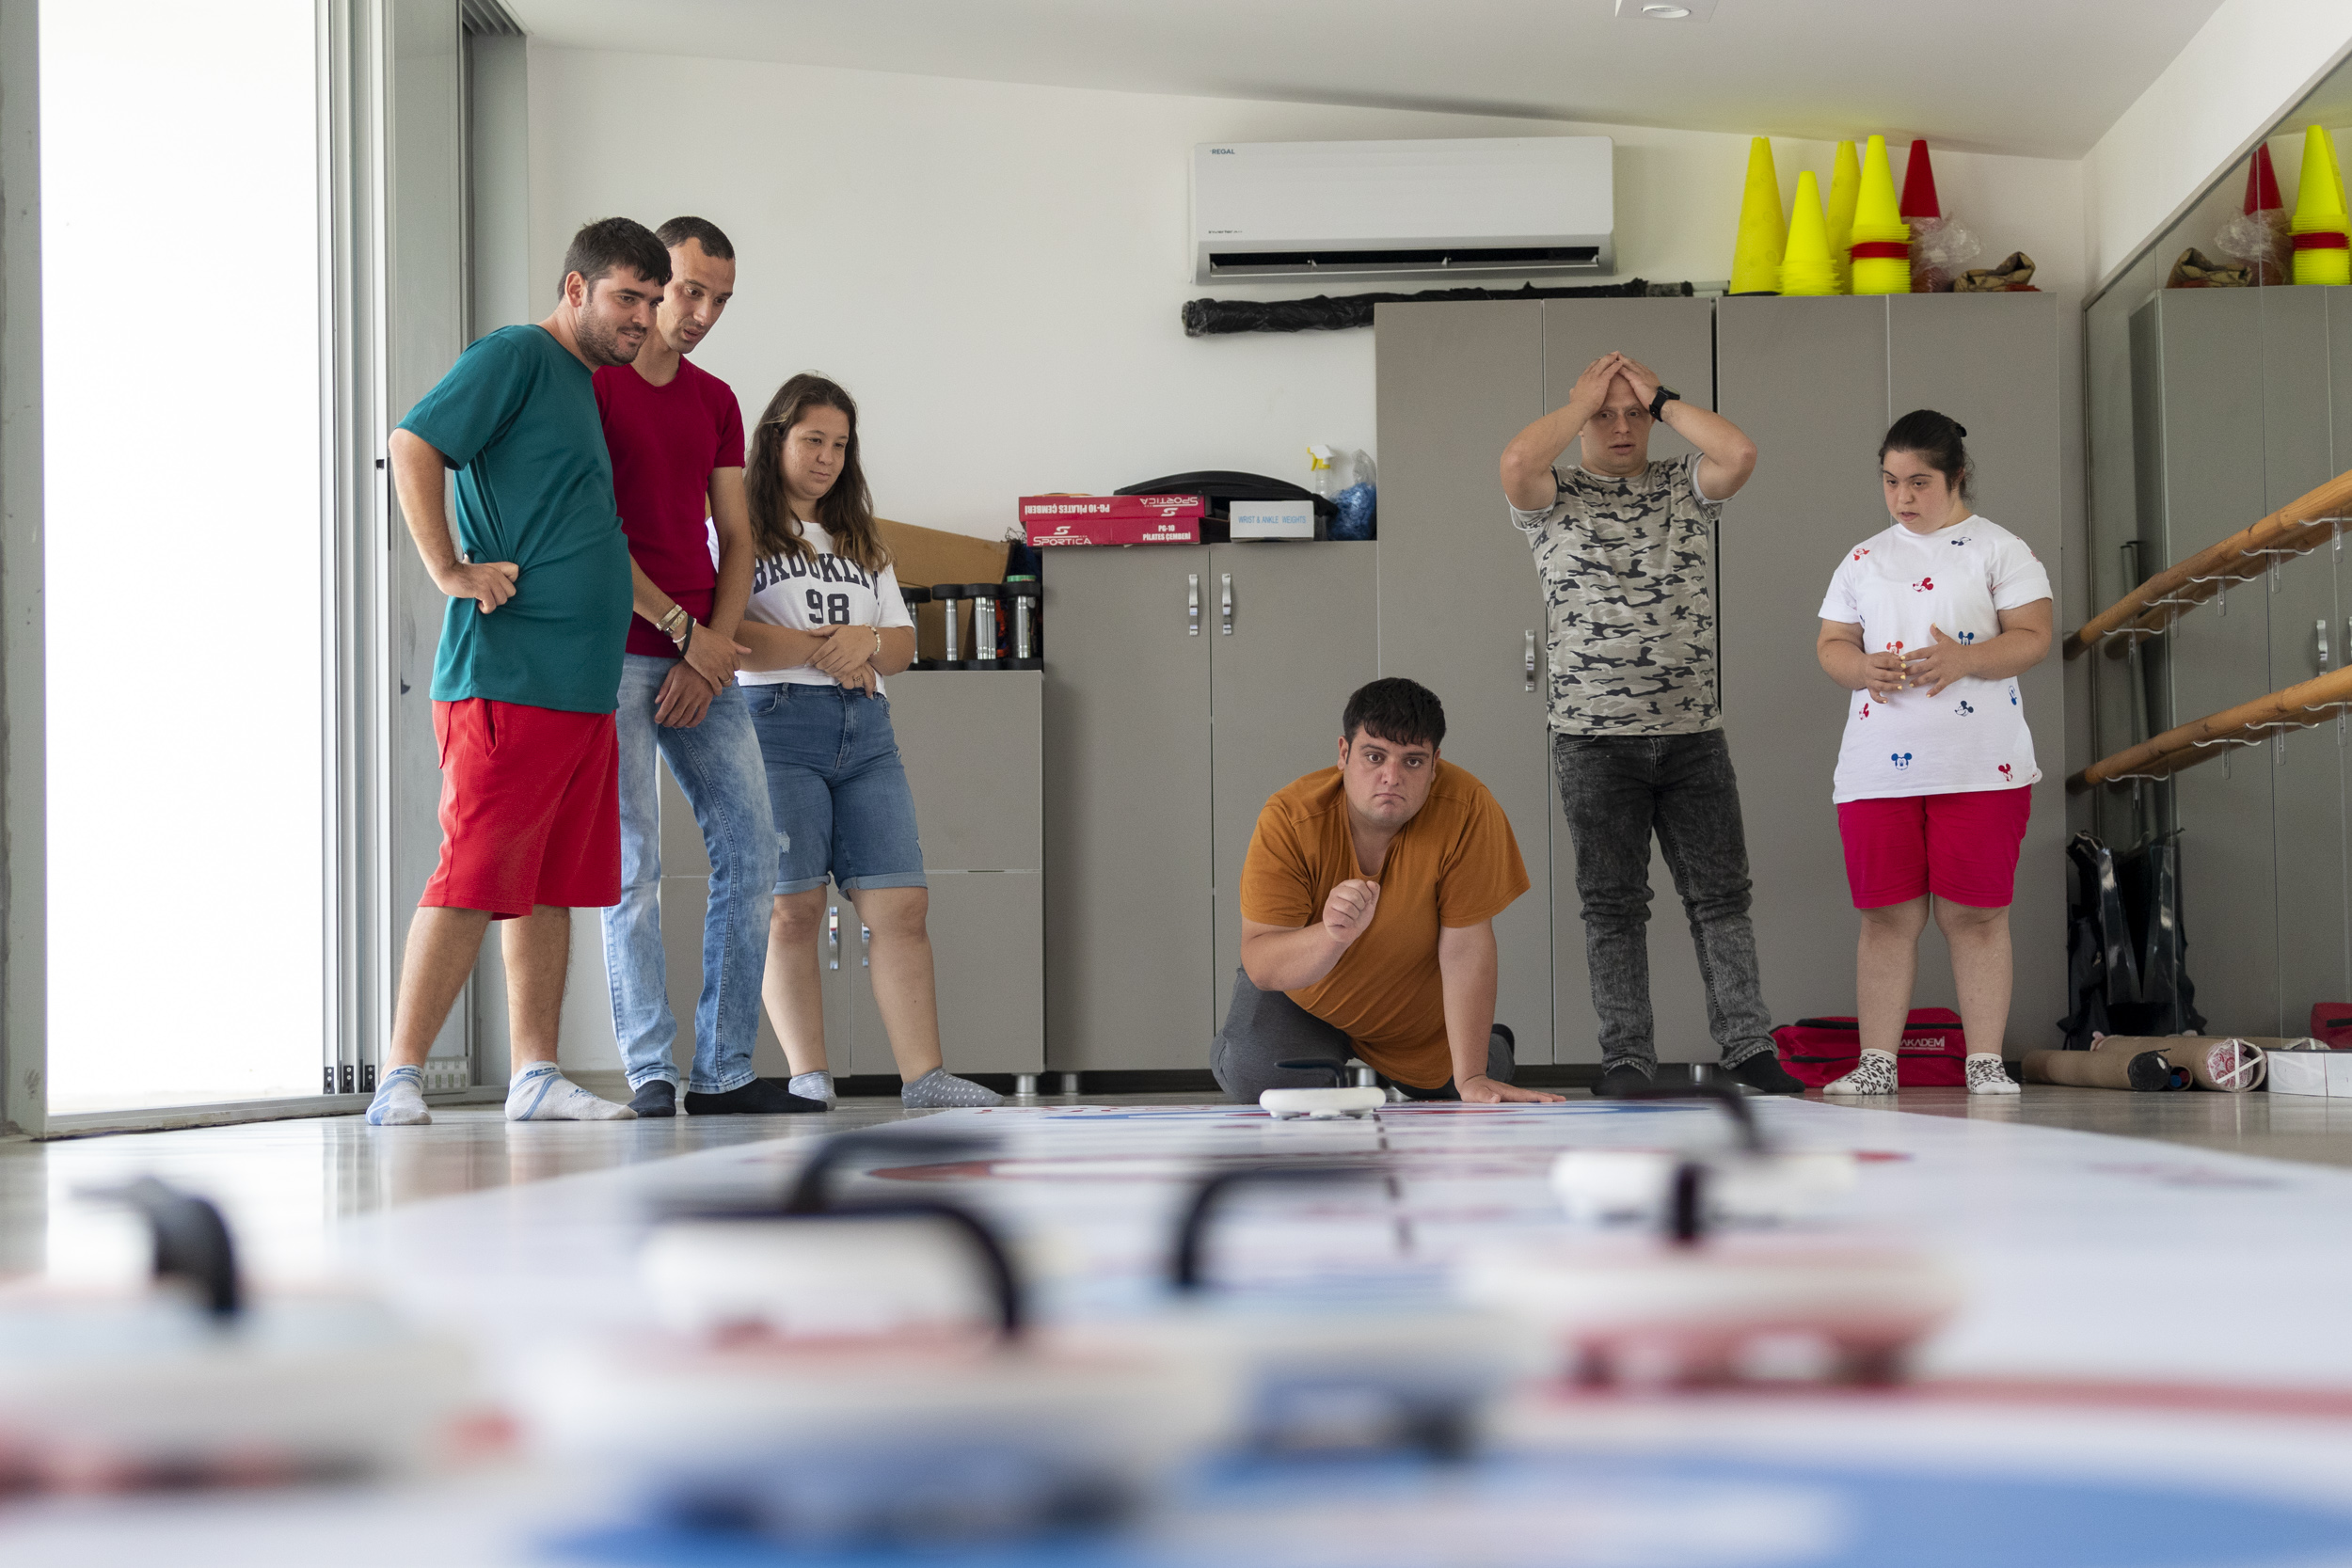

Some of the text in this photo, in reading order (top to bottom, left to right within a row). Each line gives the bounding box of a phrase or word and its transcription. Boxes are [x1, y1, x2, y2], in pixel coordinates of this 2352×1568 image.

[1139, 497, 1199, 507] SPORTICA
[1089, 504, 1110, 513] PG-10
[1238, 515, 1307, 524] WRIST & ANKLE WEIGHTS
[1033, 535, 1092, 546] SPORTICA
[805, 589, 850, 625] 98
